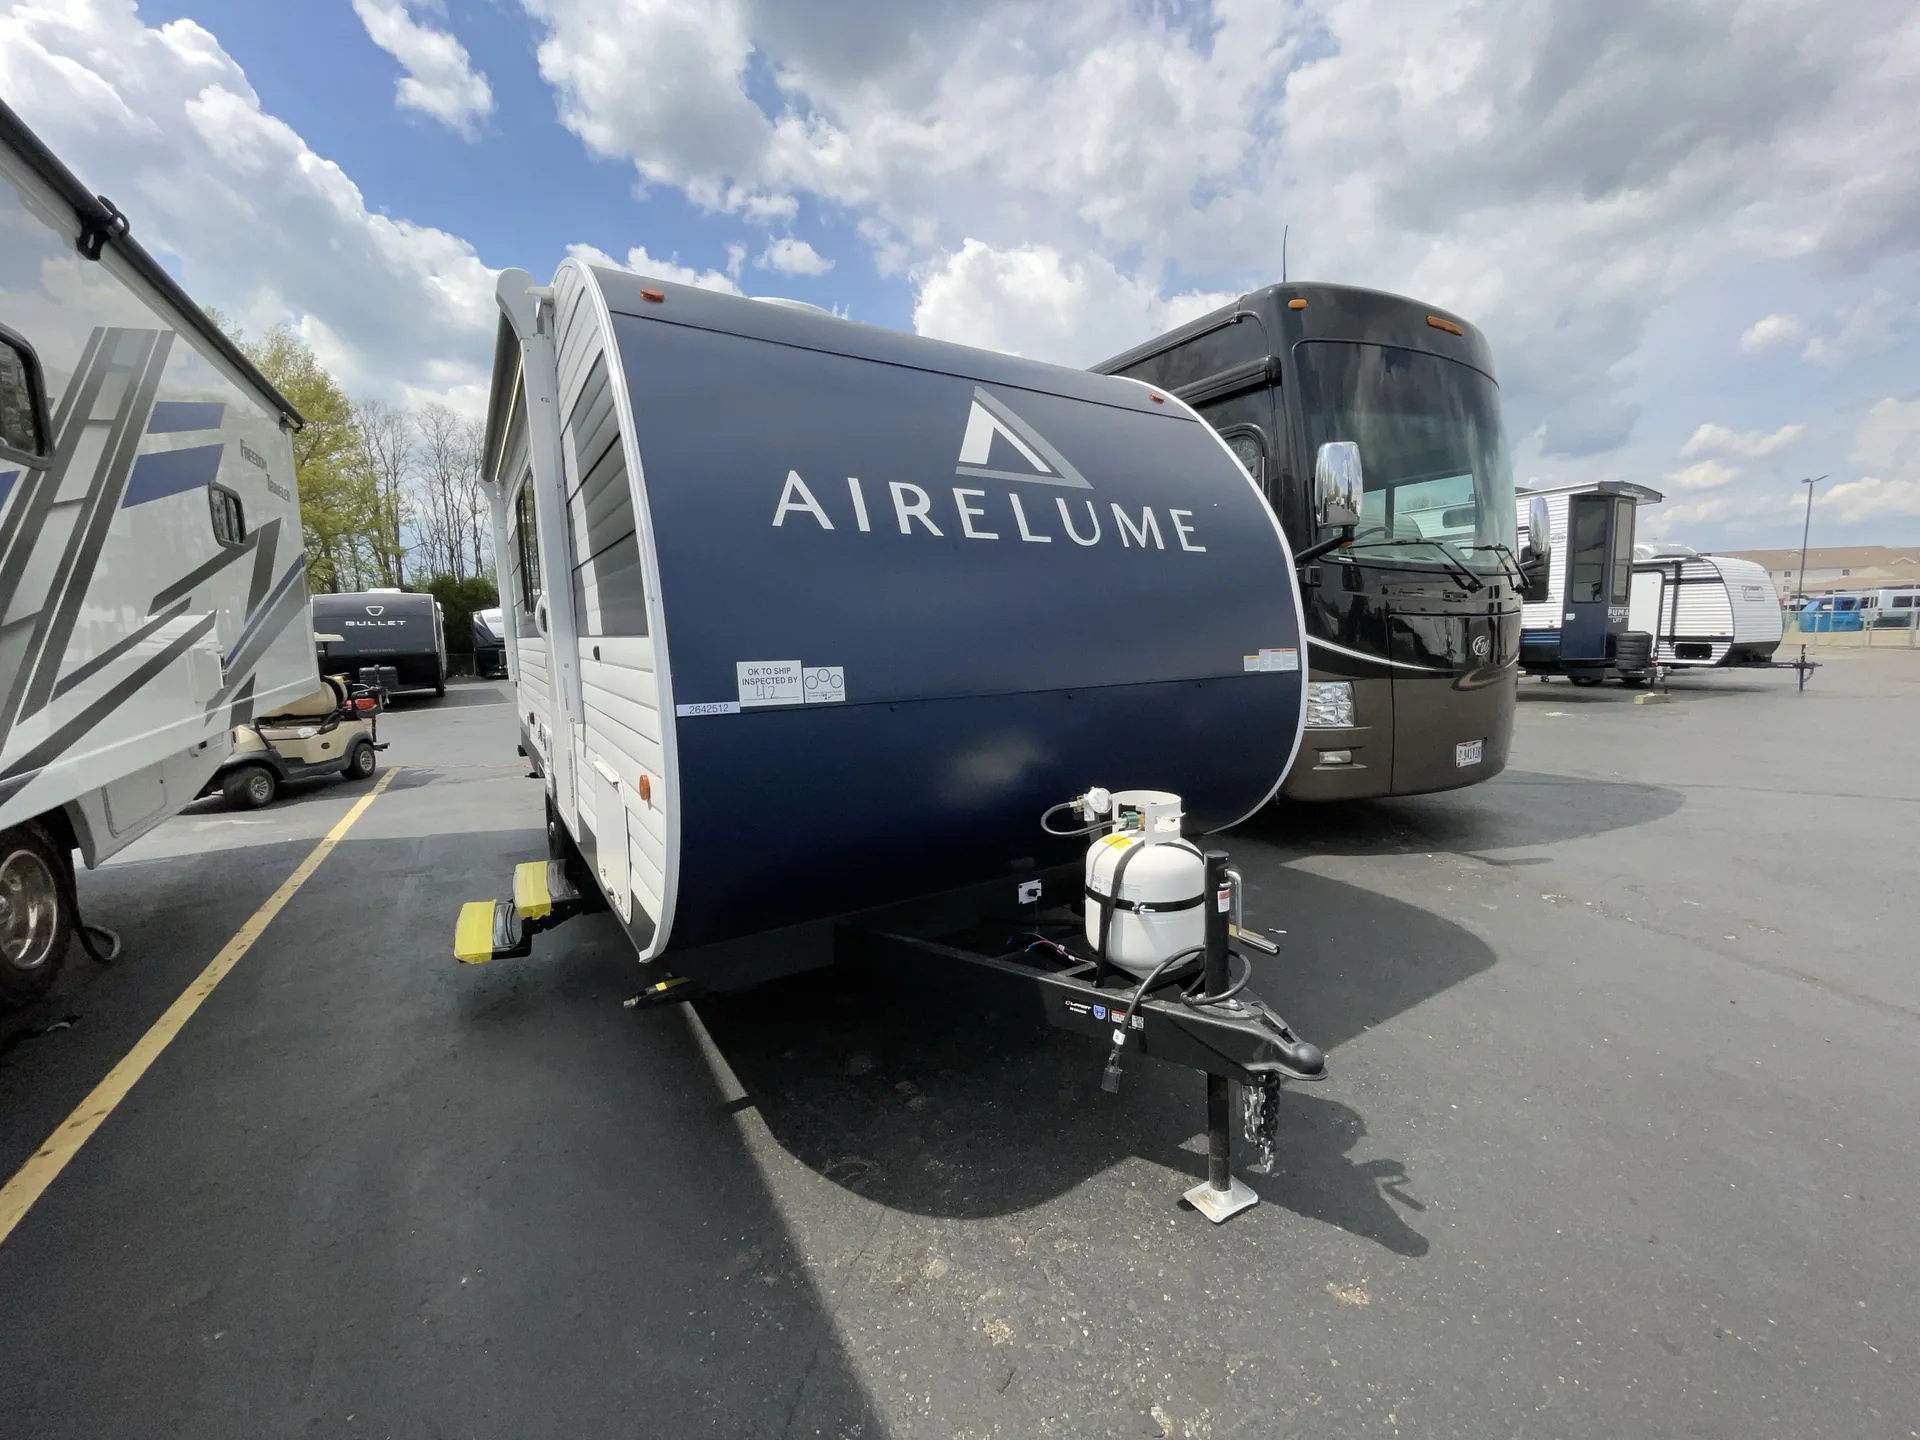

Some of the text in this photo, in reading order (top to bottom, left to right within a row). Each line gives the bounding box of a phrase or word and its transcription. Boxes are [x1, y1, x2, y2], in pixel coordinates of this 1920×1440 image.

[772, 470, 1207, 552] AIRELUME
[747, 666, 791, 676] OK TO SHIP
[742, 676, 798, 686] INSPECTED BY
[689, 703, 729, 714] 2642512
